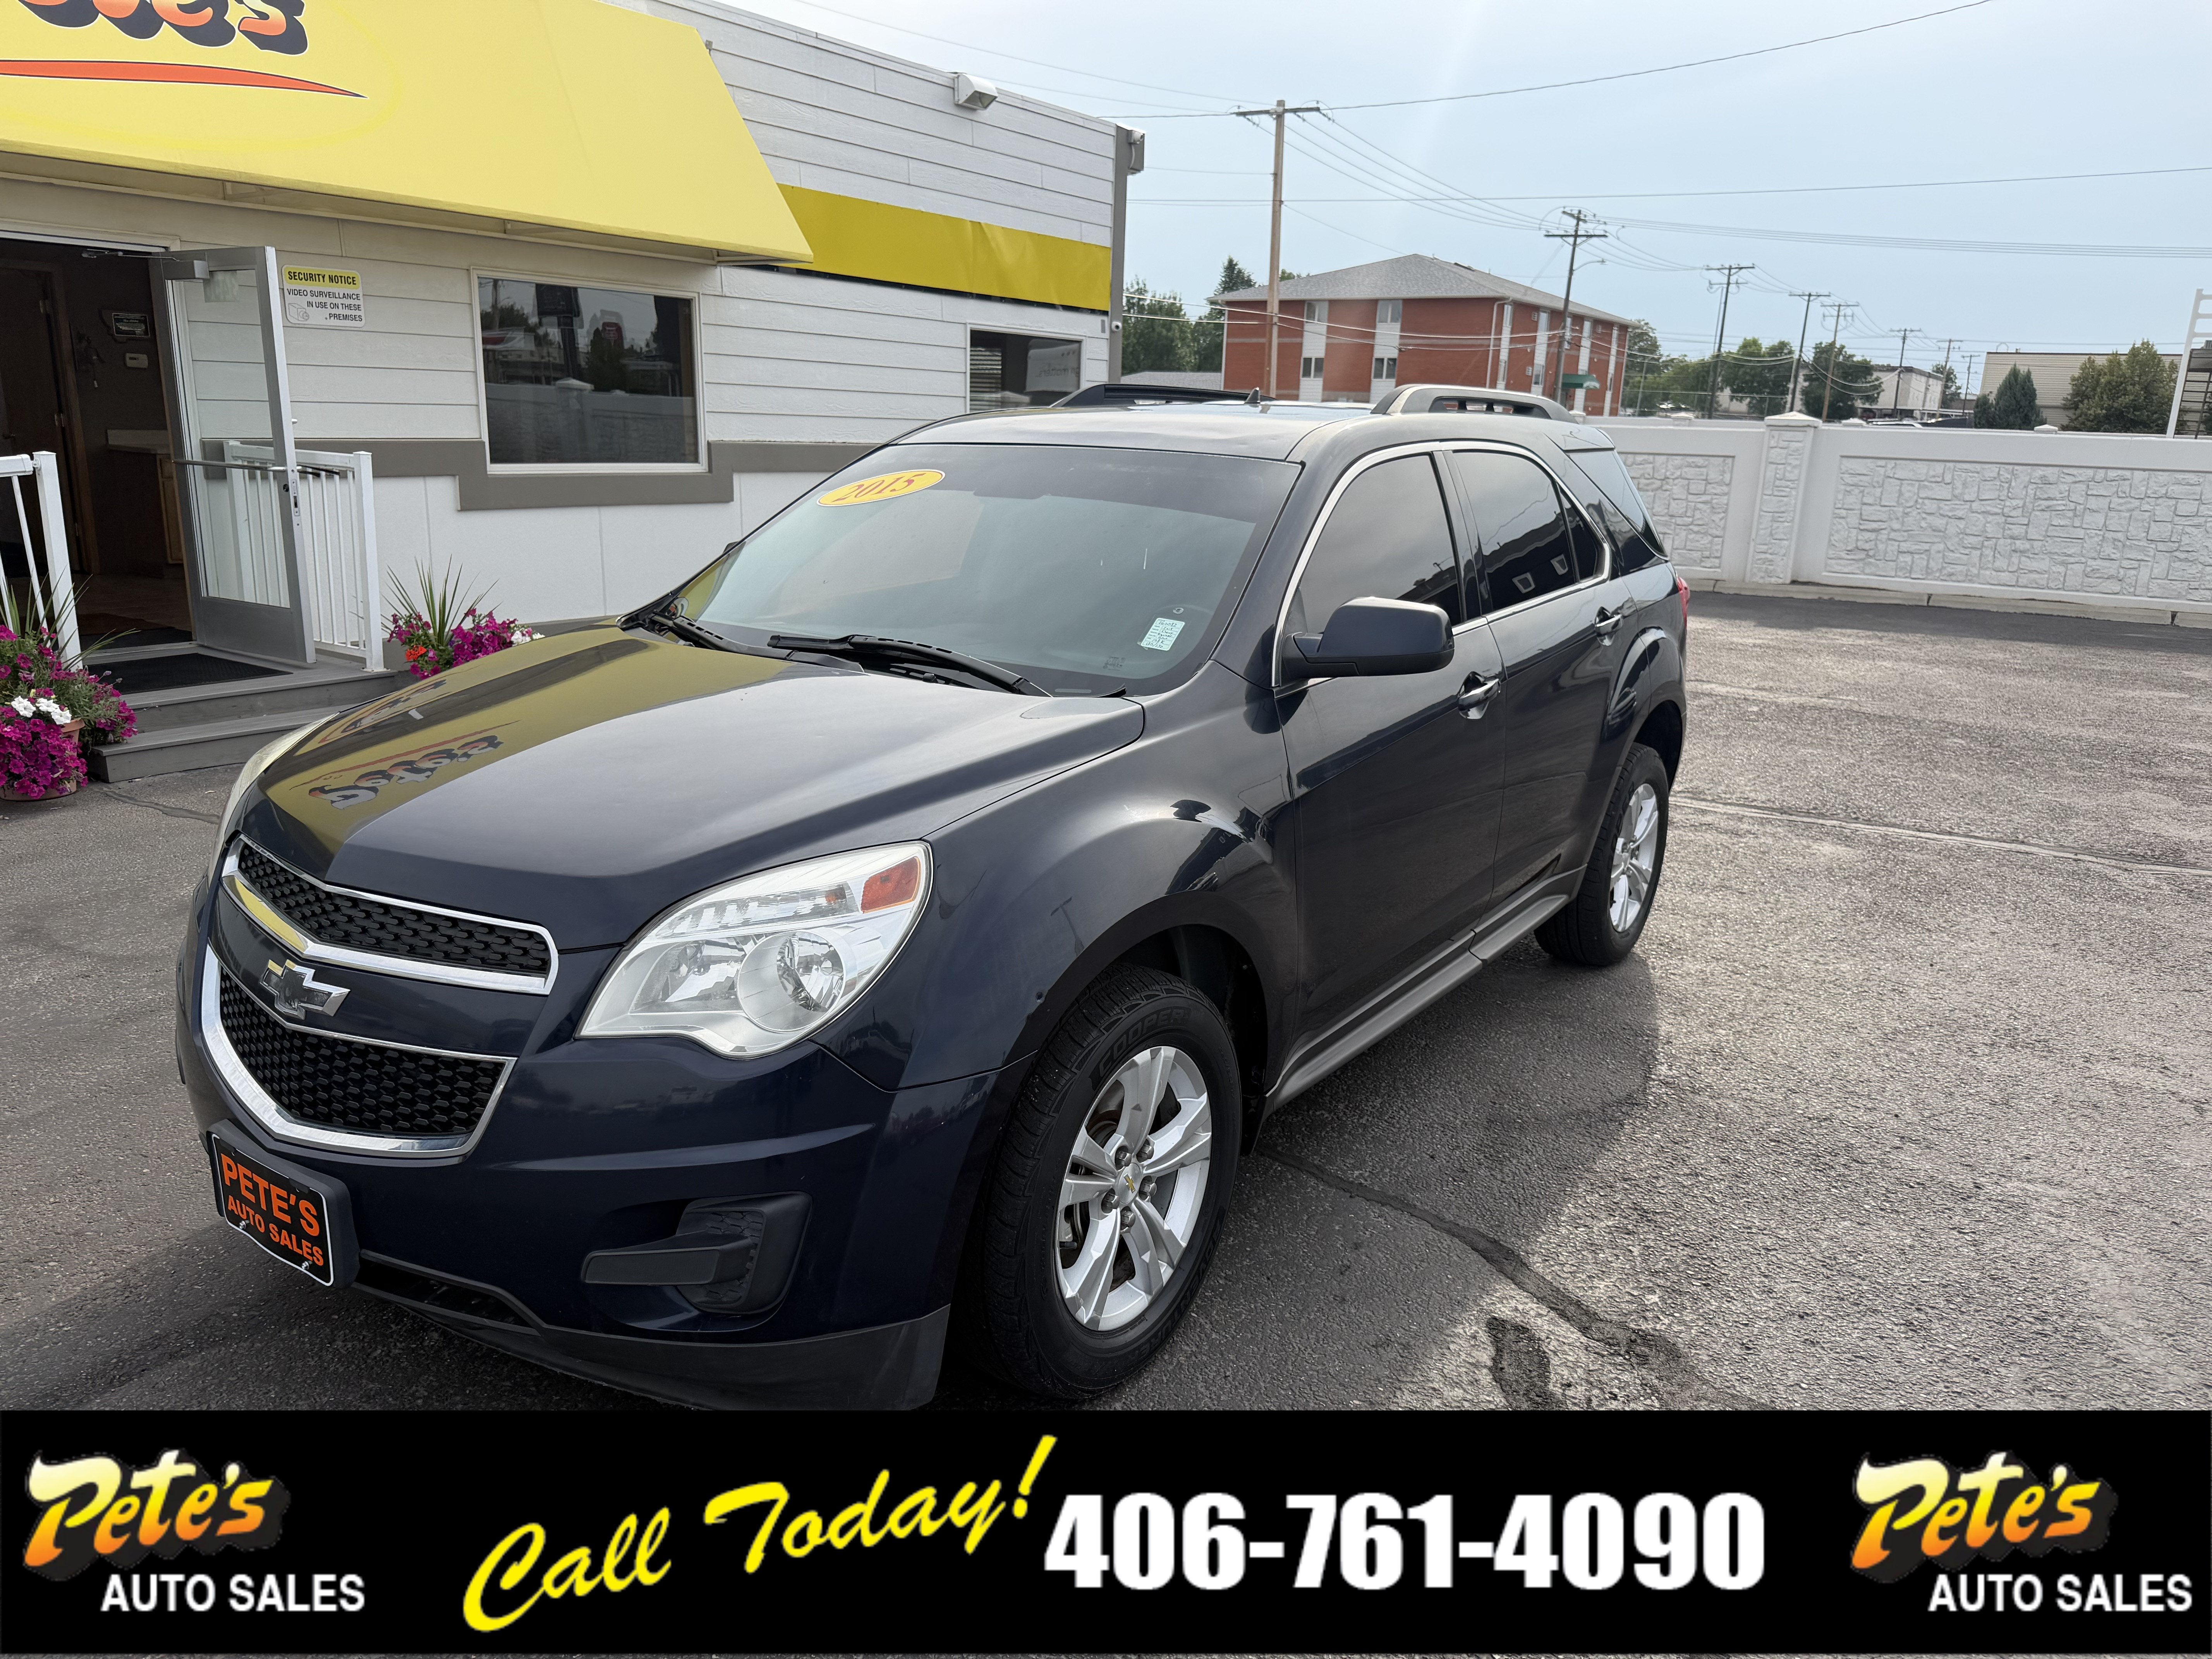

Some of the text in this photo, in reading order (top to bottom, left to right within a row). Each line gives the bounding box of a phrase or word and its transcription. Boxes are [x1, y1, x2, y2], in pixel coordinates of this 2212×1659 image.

[288, 271, 357, 285] SECURITY NOTICE
[287, 288, 361, 301] VIDEO SURVEILLANCE
[329, 313, 363, 322] PREMISES
[831, 472, 927, 503] 2015
[1099, 1008, 1185, 1078] COOPER
[221, 1153, 319, 1237] PETE'S
[228, 1195, 323, 1266] AUTO SALES
